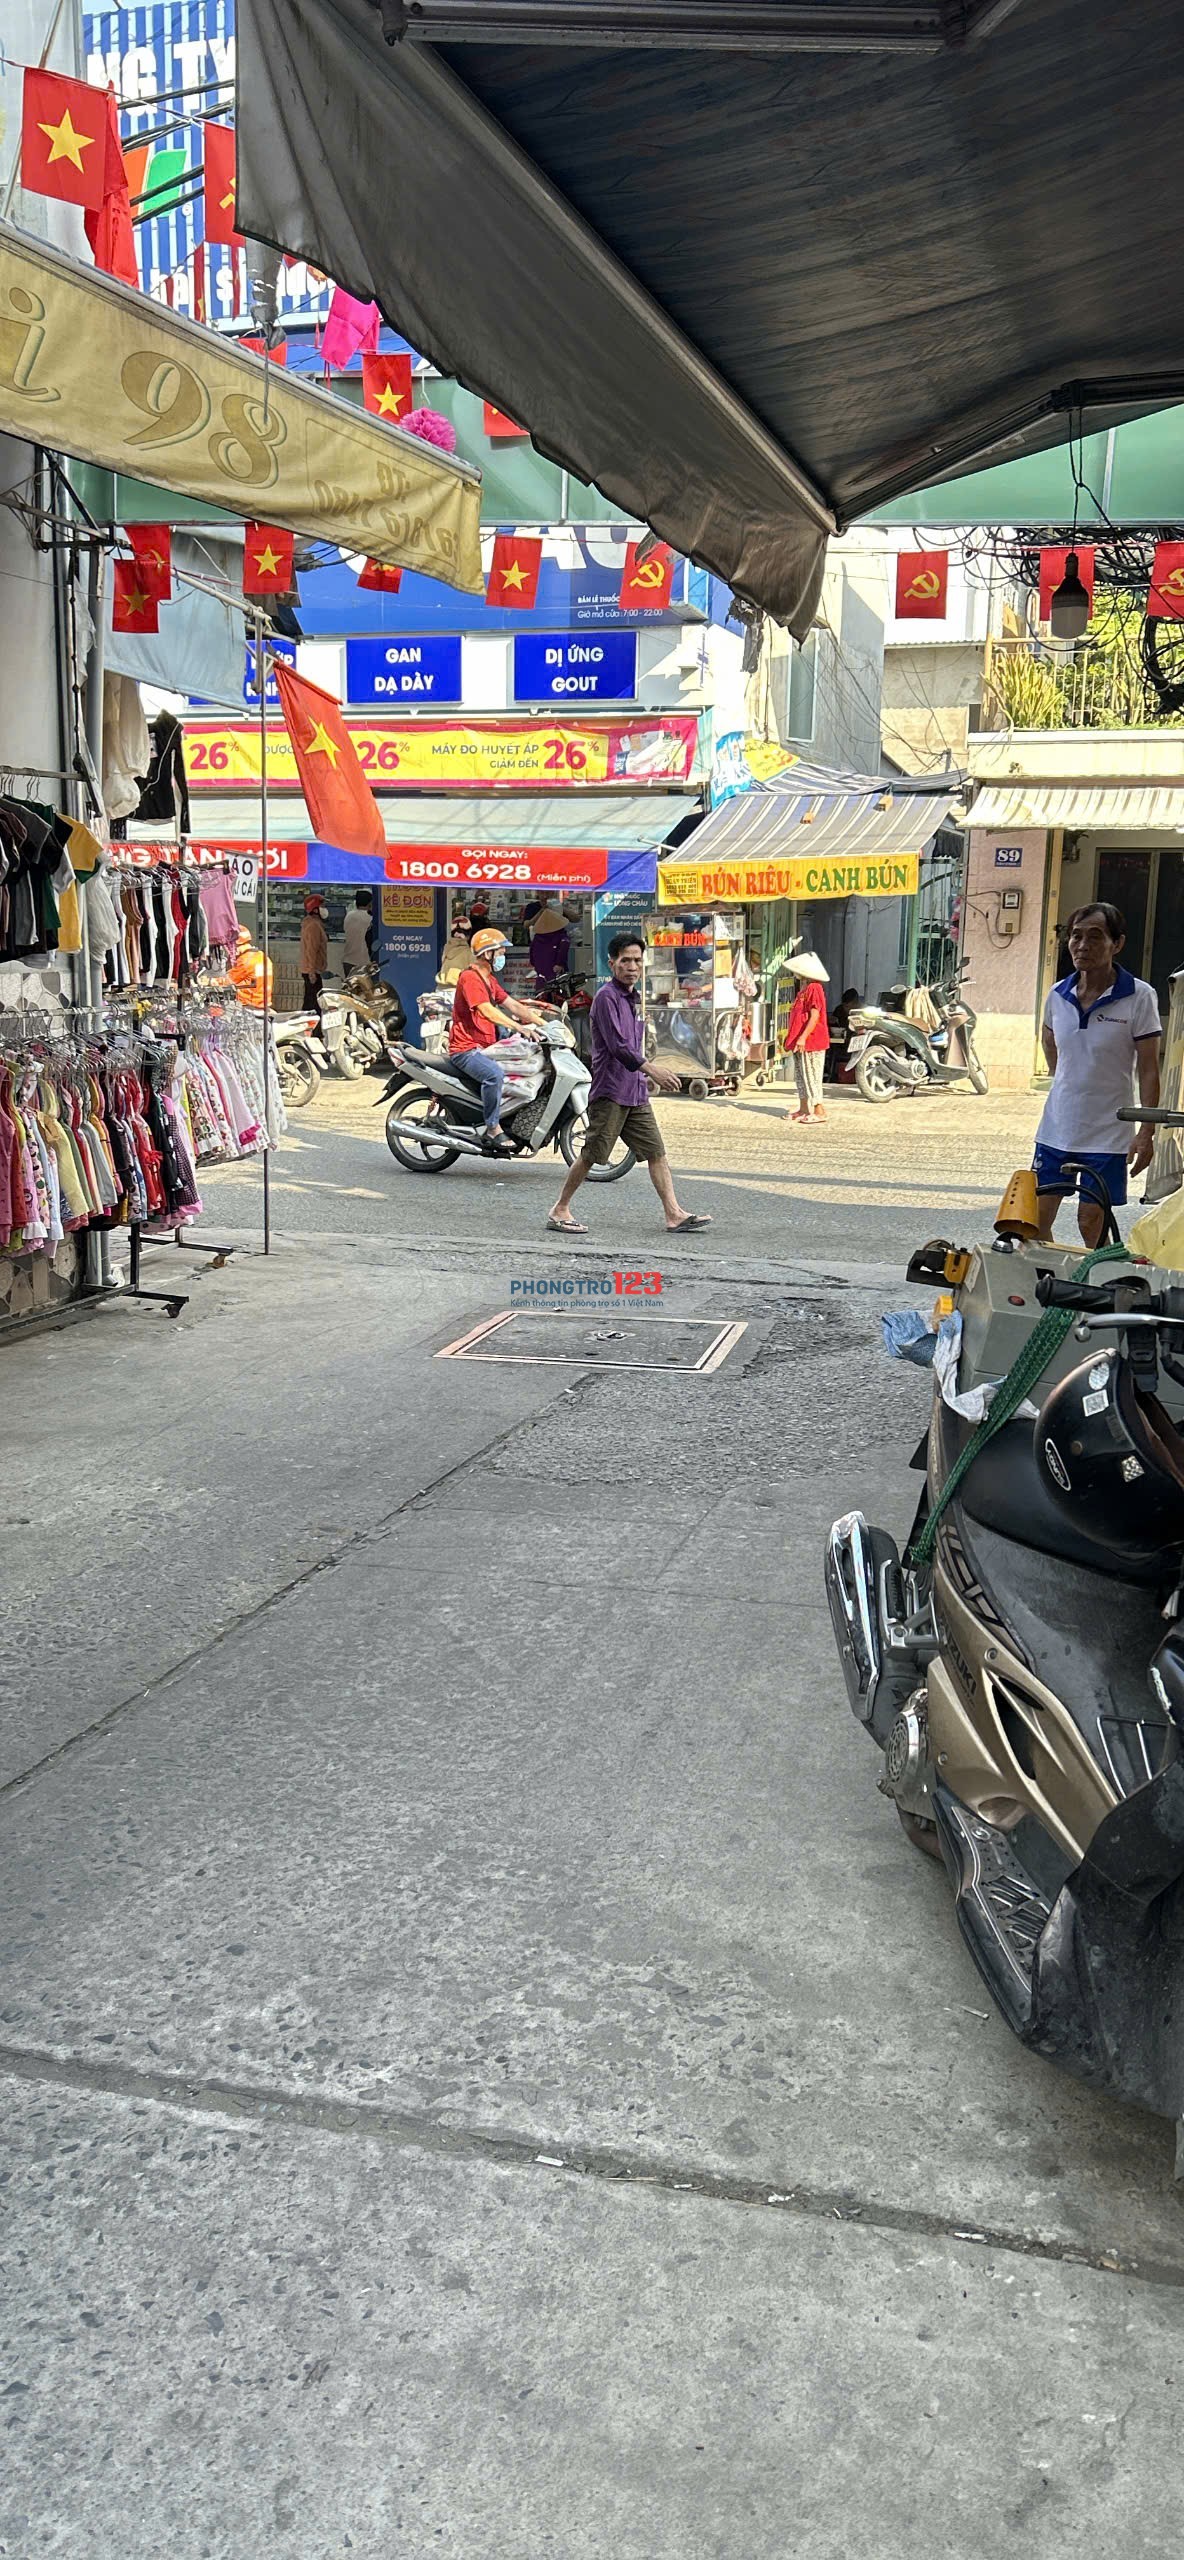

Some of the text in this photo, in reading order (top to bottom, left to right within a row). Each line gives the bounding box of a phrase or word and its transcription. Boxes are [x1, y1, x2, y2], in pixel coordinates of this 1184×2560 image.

[120, 350, 288, 490] 98
[577, 609, 591, 619] Giờ
[386, 647, 421, 664] GAN
[545, 643, 604, 668] DỊ ỨNG
[374, 670, 434, 695] DẠ DÀY
[551, 676, 598, 693] GOUT
[432, 741, 539, 755] MÁY ĐO HUYẾT ÁP
[518, 756, 539, 769] ĐẾN
[462, 849, 528, 860] GỌI NGAY:
[997, 849, 1020, 862] 89
[400, 861, 459, 880] 1800
[466, 863, 531, 881] 6928
[806, 859, 908, 893] CANH BÚN
[701, 866, 741, 897] BÚN
[745, 864, 790, 896] RIÊU
[385, 943, 431, 953] 1800 6928
